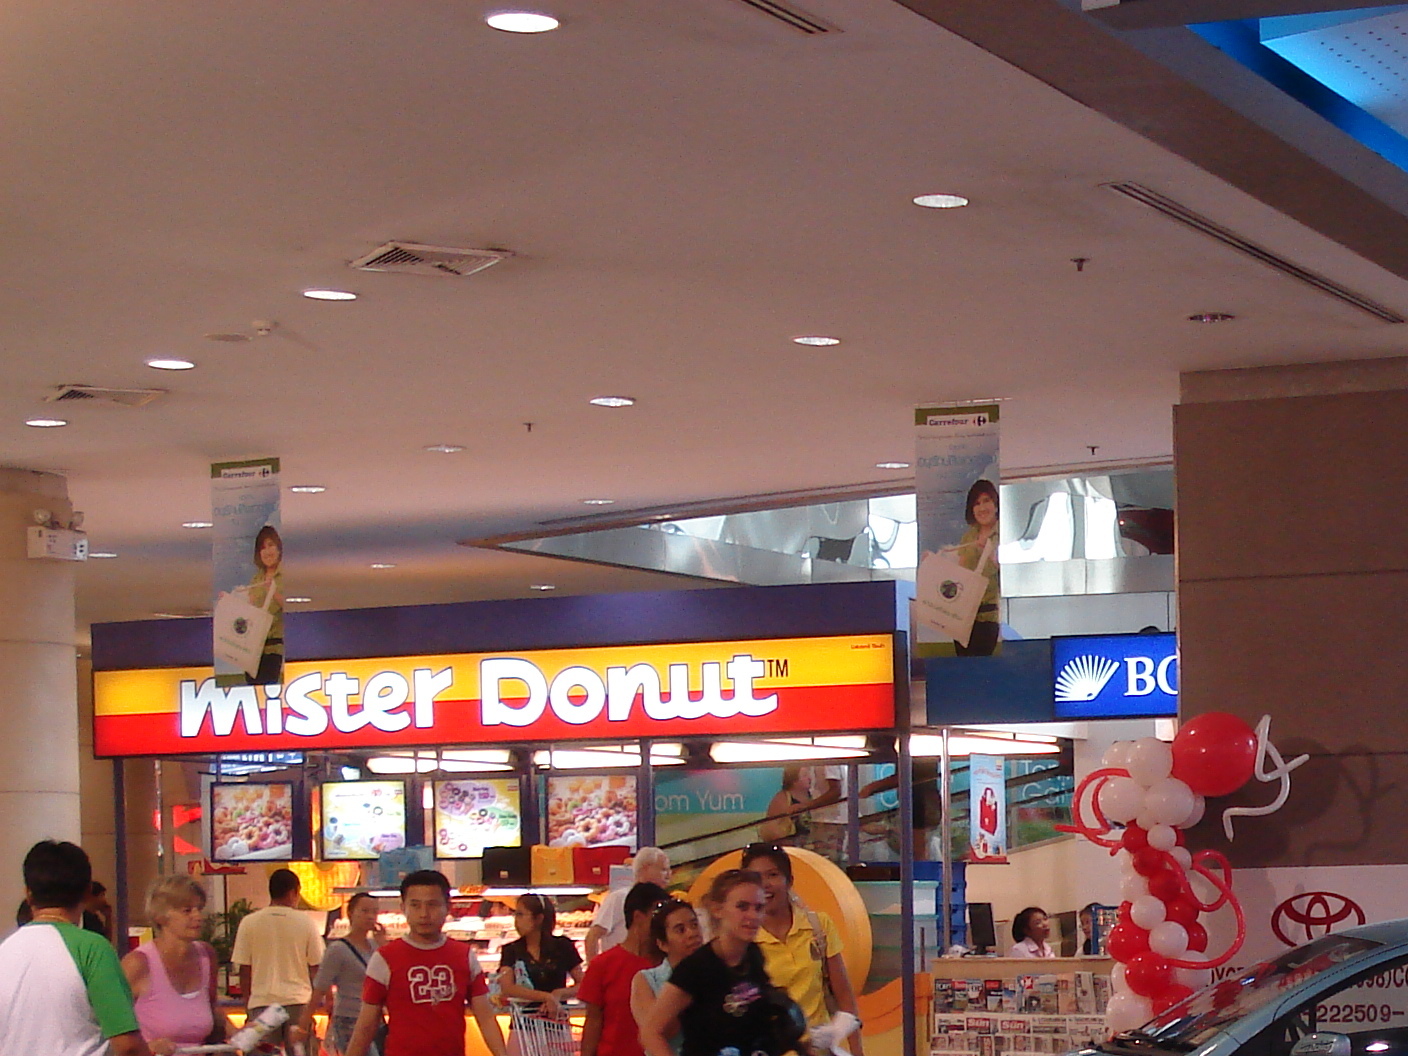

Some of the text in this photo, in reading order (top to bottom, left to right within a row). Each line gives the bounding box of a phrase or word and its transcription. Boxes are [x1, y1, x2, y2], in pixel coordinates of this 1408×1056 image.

[929, 418, 969, 426] Carrefour
[180, 666, 454, 738] Mister
[480, 654, 779, 728] Donut
[655, 789, 744, 811] om Yum
[407, 965, 455, 1003] 23
